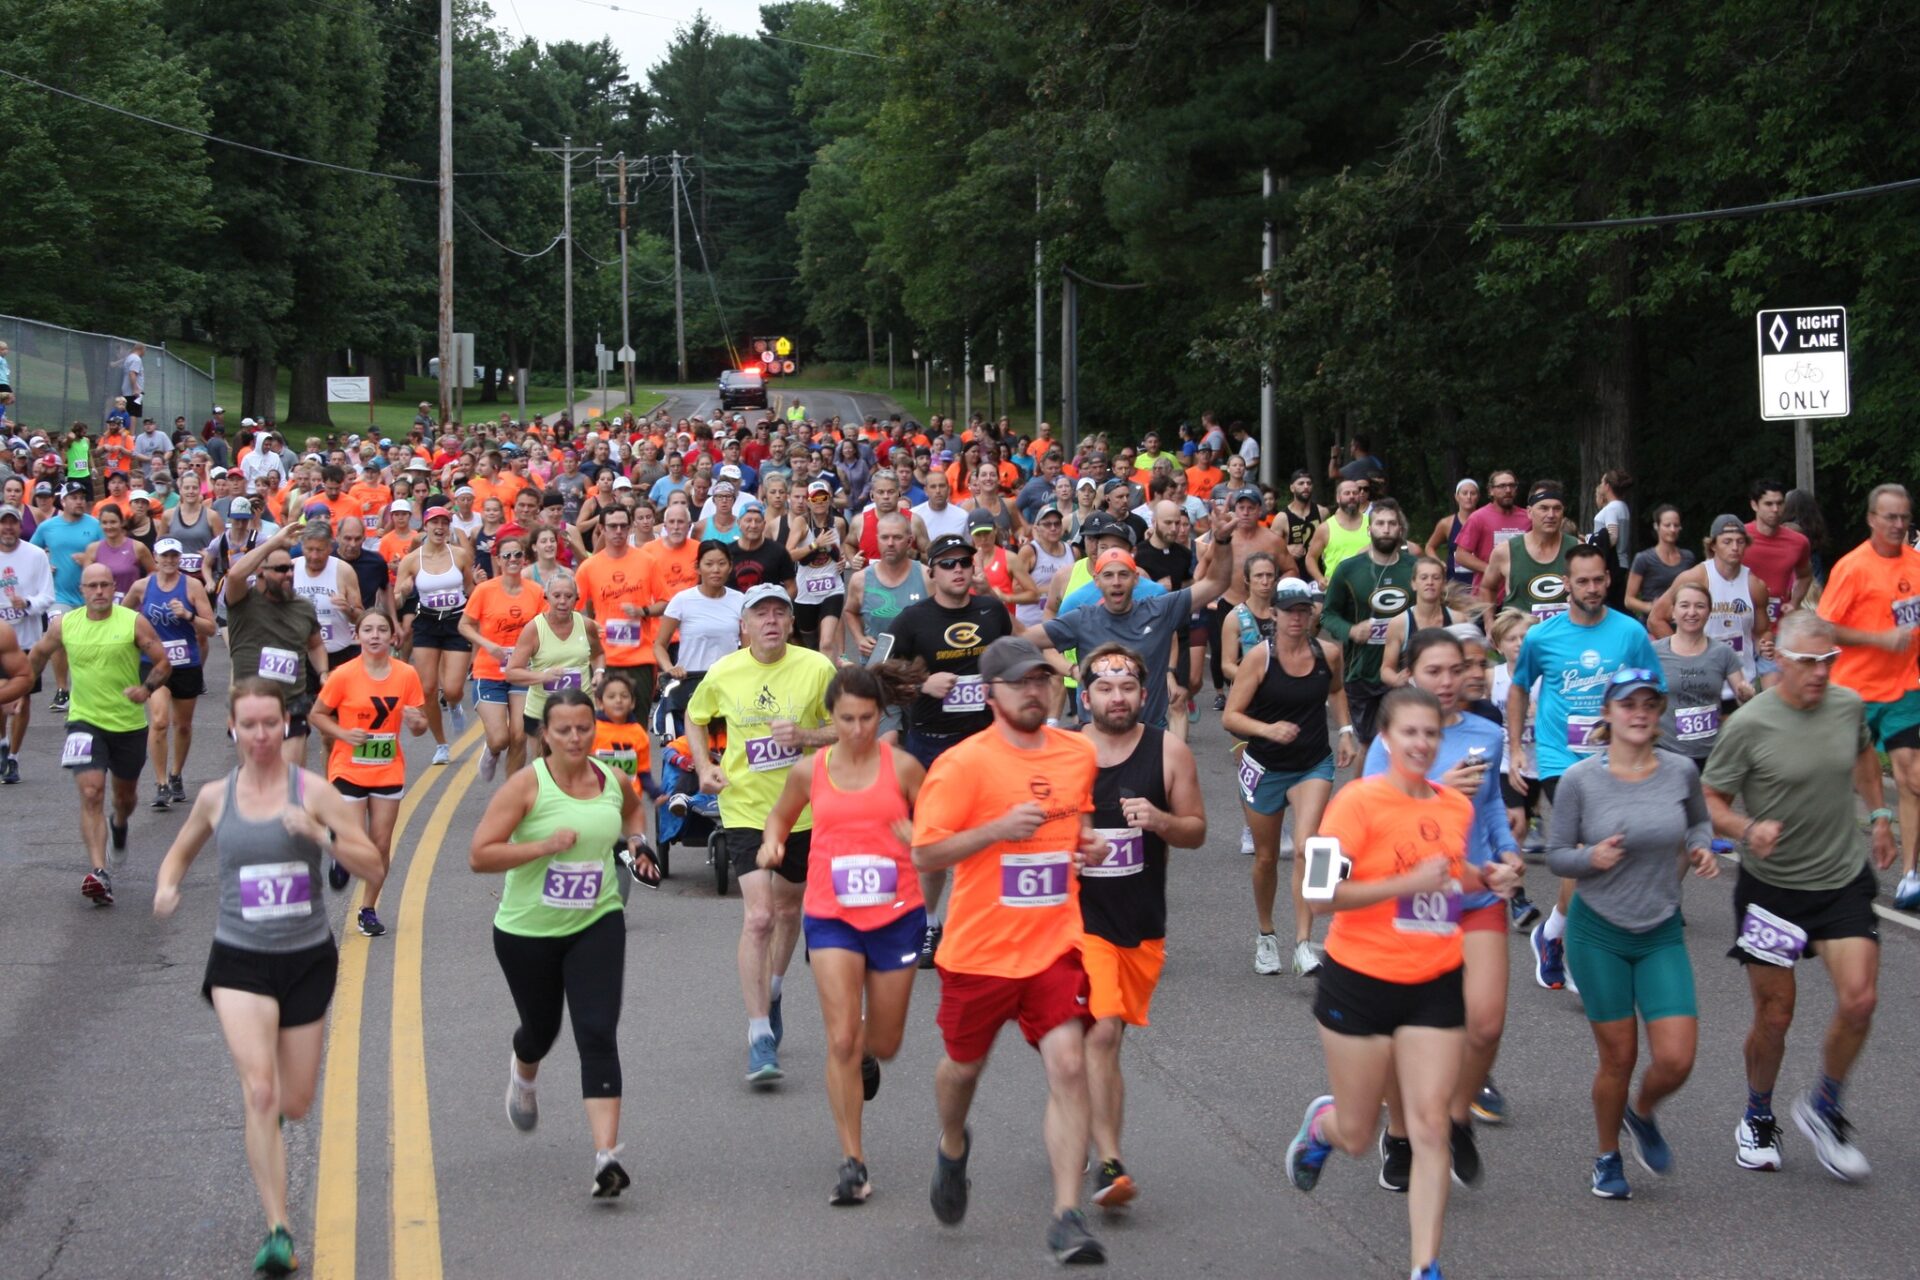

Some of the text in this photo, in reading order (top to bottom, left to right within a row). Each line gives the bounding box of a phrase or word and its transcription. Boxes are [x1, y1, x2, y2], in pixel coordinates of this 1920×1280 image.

[1796, 314, 1840, 330] RIGHT
[1800, 333, 1839, 348] LANE
[1779, 390, 1830, 410] ONLY
[179, 558, 199, 568] 227
[808, 579, 833, 592] 278
[431, 594, 456, 606] 116
[613, 623, 632, 640] 73
[264, 656, 295, 674] 379
[949, 683, 986, 704] 368
[1682, 714, 1712, 734] 361
[361, 741, 392, 758] 118
[549, 873, 597, 898] 375
[847, 867, 881, 894] 59
[1017, 867, 1053, 896] 61
[257, 876, 293, 906] 37
[1412, 891, 1449, 921] 60
[1743, 919, 1795, 957] 392
